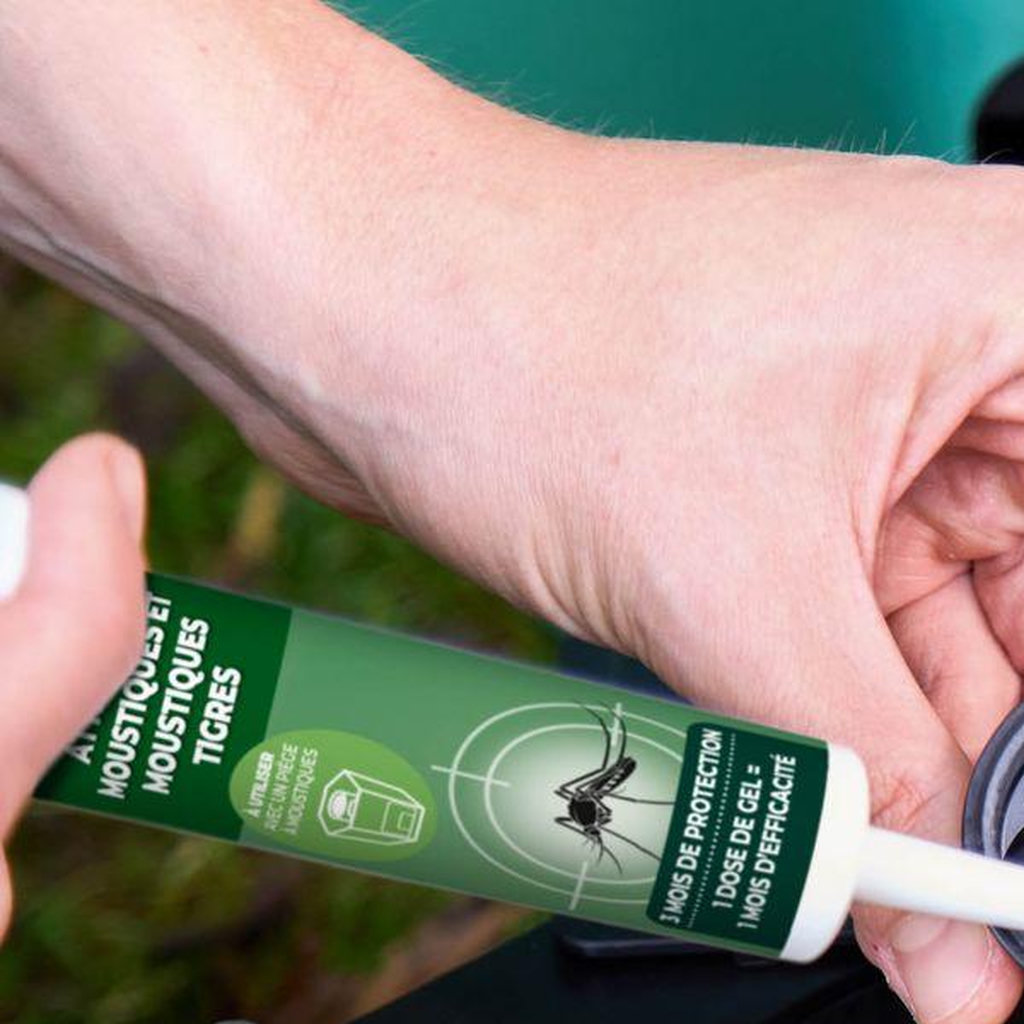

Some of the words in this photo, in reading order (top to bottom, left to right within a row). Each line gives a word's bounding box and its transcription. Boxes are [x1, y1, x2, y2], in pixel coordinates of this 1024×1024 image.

[97, 626, 165, 799] MOUSTIQUES
[148, 591, 171, 622] ET
[141, 616, 210, 794] MOUSTIQUES
[193, 666, 241, 765] TIGRES
[249, 752, 274, 807] UTILISER
[275, 743, 298, 782] PIÈGE
[683, 728, 723, 841] PROTECTION
[747, 764, 761, 776] =
[271, 781, 290, 802] UN
[286, 747, 318, 826] MOUSTIQUES
[737, 780, 762, 814] GEL
[729, 816, 755, 847] DE
[754, 752, 797, 875] D'EFFICACITÉ
[676, 842, 701, 871] DE
[715, 847, 748, 900] DOSE
[659, 912, 680, 924] 3
[663, 872, 694, 918] MOIS
[711, 899, 734, 909] 1
[741, 876, 771, 922] MOIS
[737, 920, 758, 929] 1
